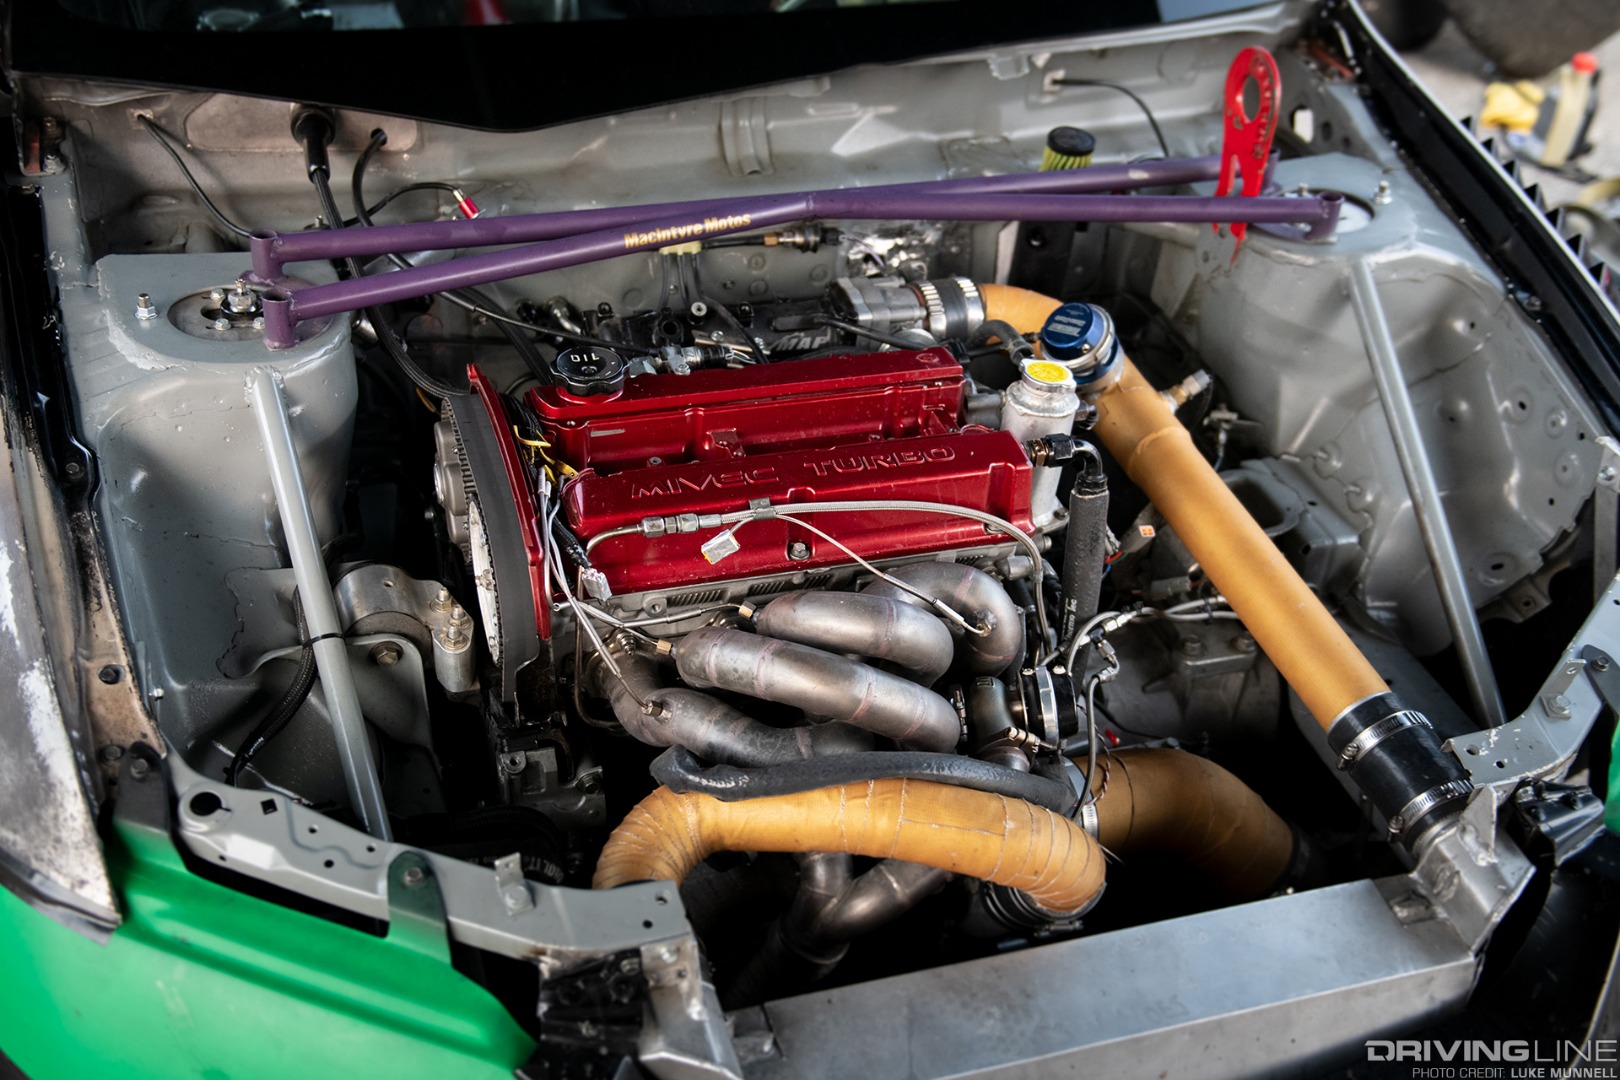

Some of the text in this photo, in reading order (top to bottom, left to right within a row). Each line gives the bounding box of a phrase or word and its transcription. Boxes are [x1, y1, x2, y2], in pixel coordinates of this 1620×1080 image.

[570, 353, 600, 362] OIL
[632, 446, 956, 498] MIVEC TURBO
